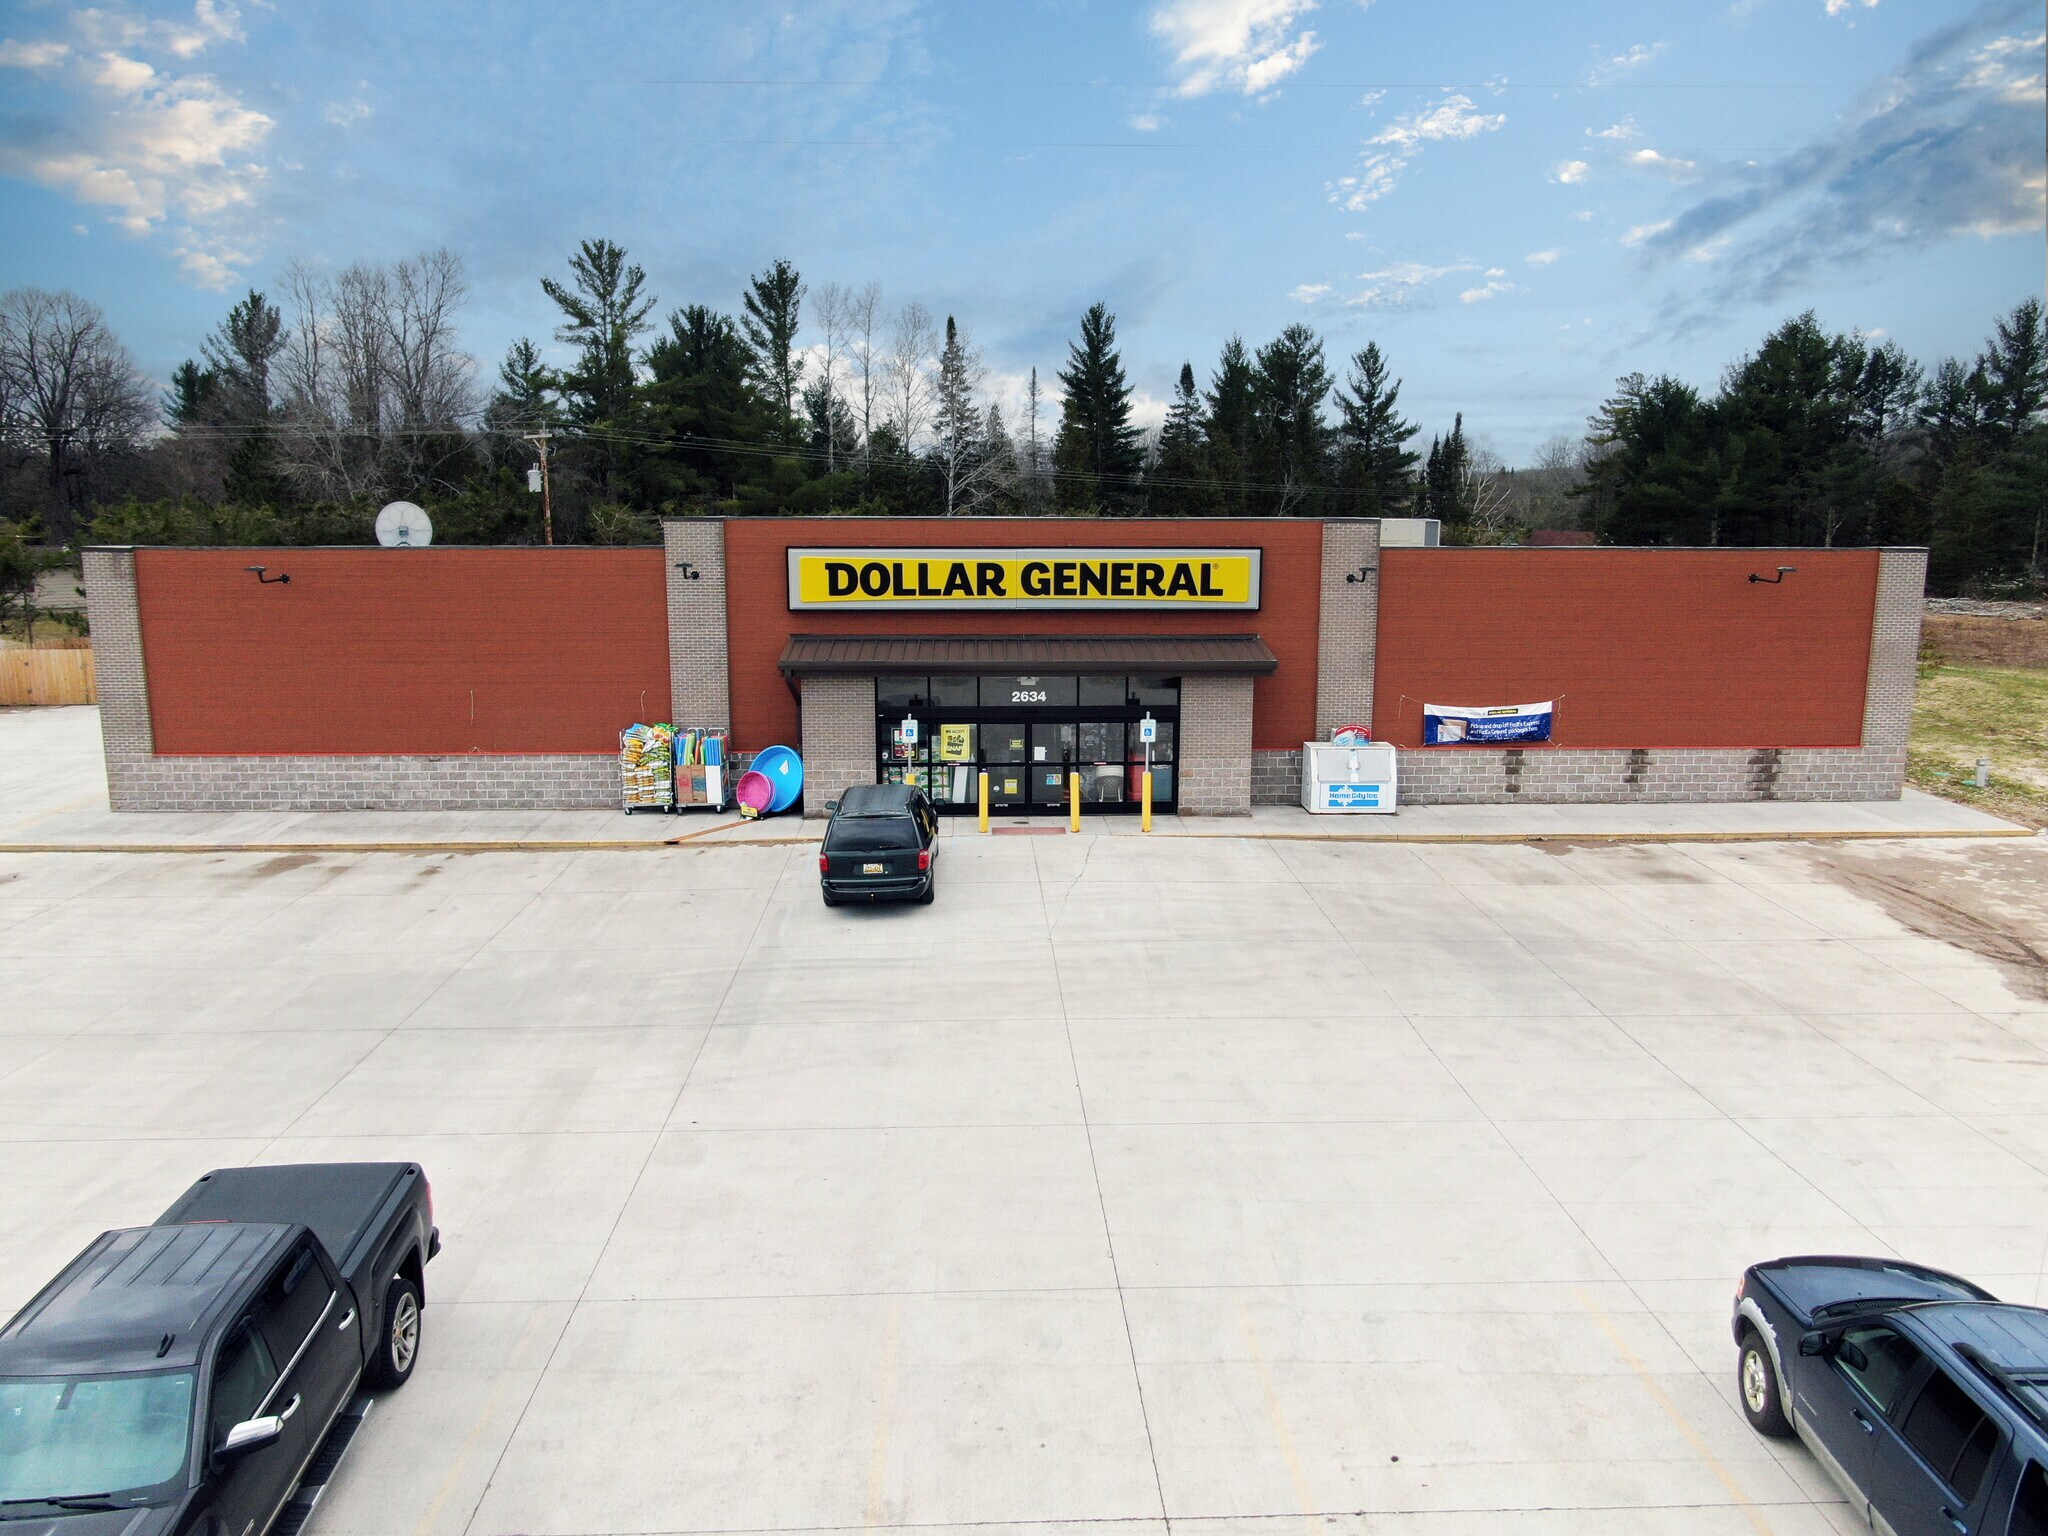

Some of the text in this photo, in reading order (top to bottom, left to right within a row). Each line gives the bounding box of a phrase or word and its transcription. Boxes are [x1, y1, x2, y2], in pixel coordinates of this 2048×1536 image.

[825, 562, 1224, 597] DOLLAR GENERAL
[1011, 691, 1047, 702] 2634
[1351, 792, 1366, 800] City
